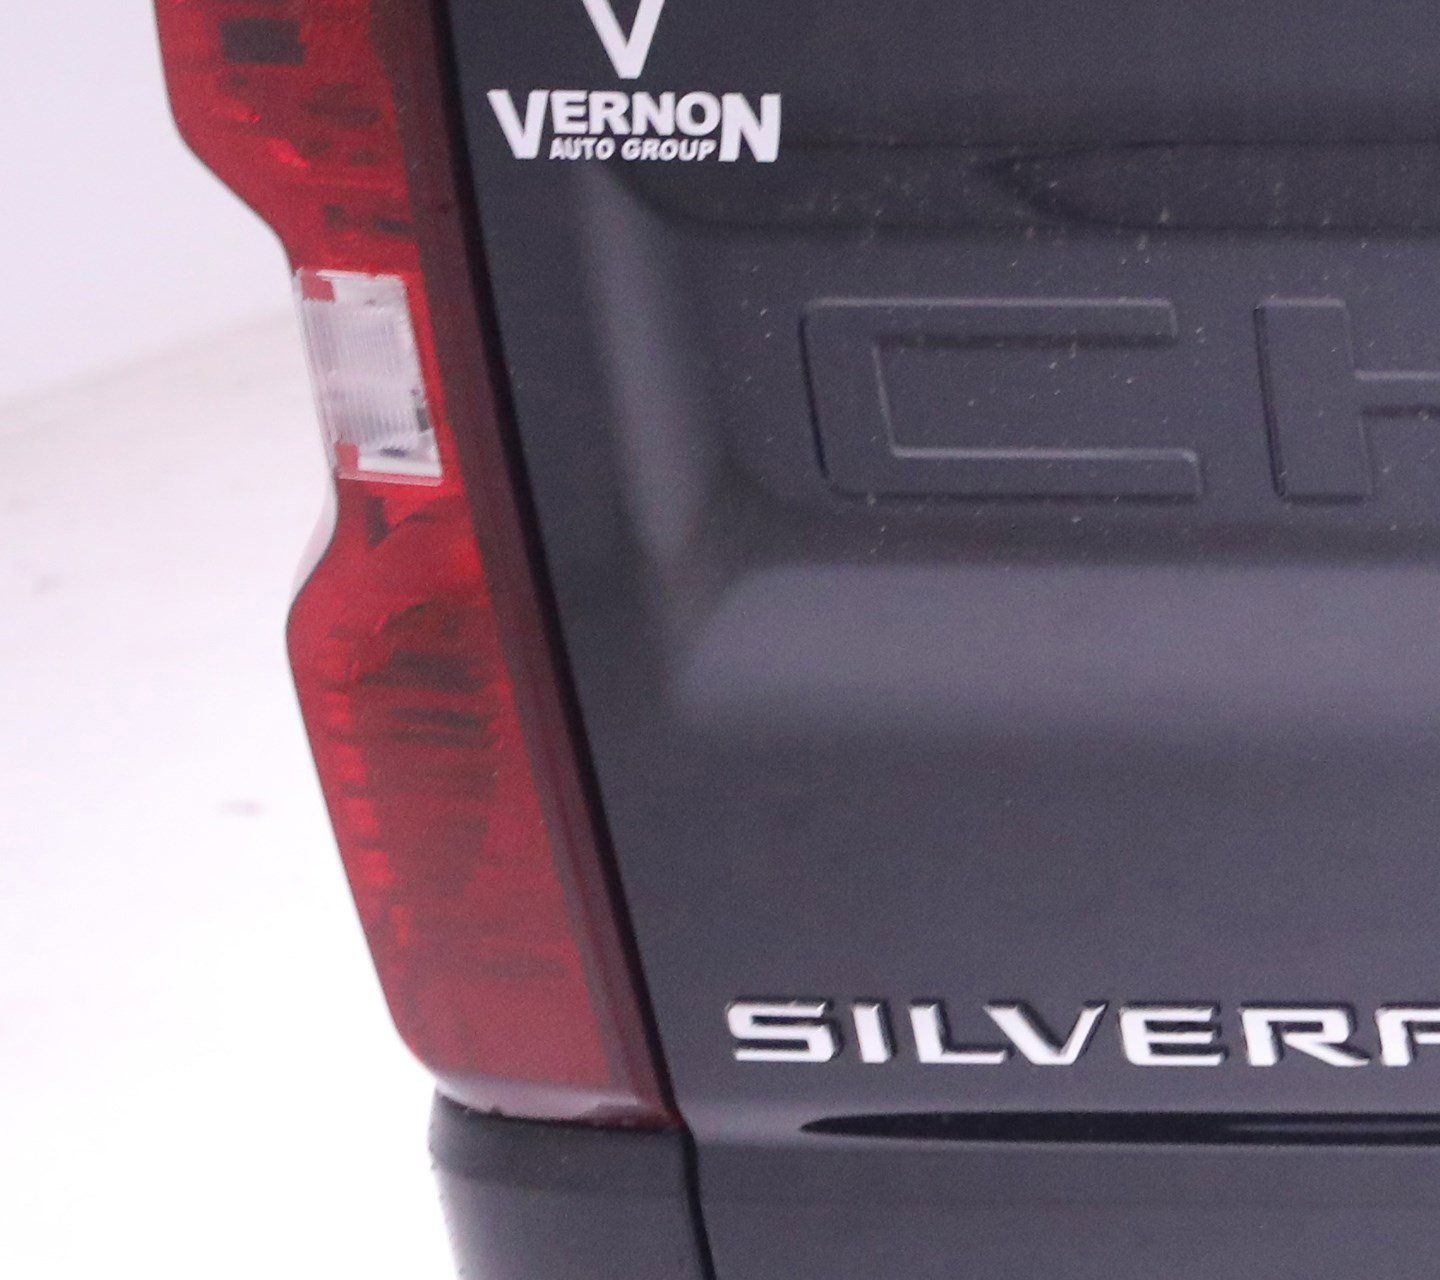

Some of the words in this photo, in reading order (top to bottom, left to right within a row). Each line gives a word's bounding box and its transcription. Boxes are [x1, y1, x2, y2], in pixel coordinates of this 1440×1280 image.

[486, 88, 782, 163] VERNON
[549, 136, 616, 161] AUTO
[620, 137, 717, 162] GROUP
